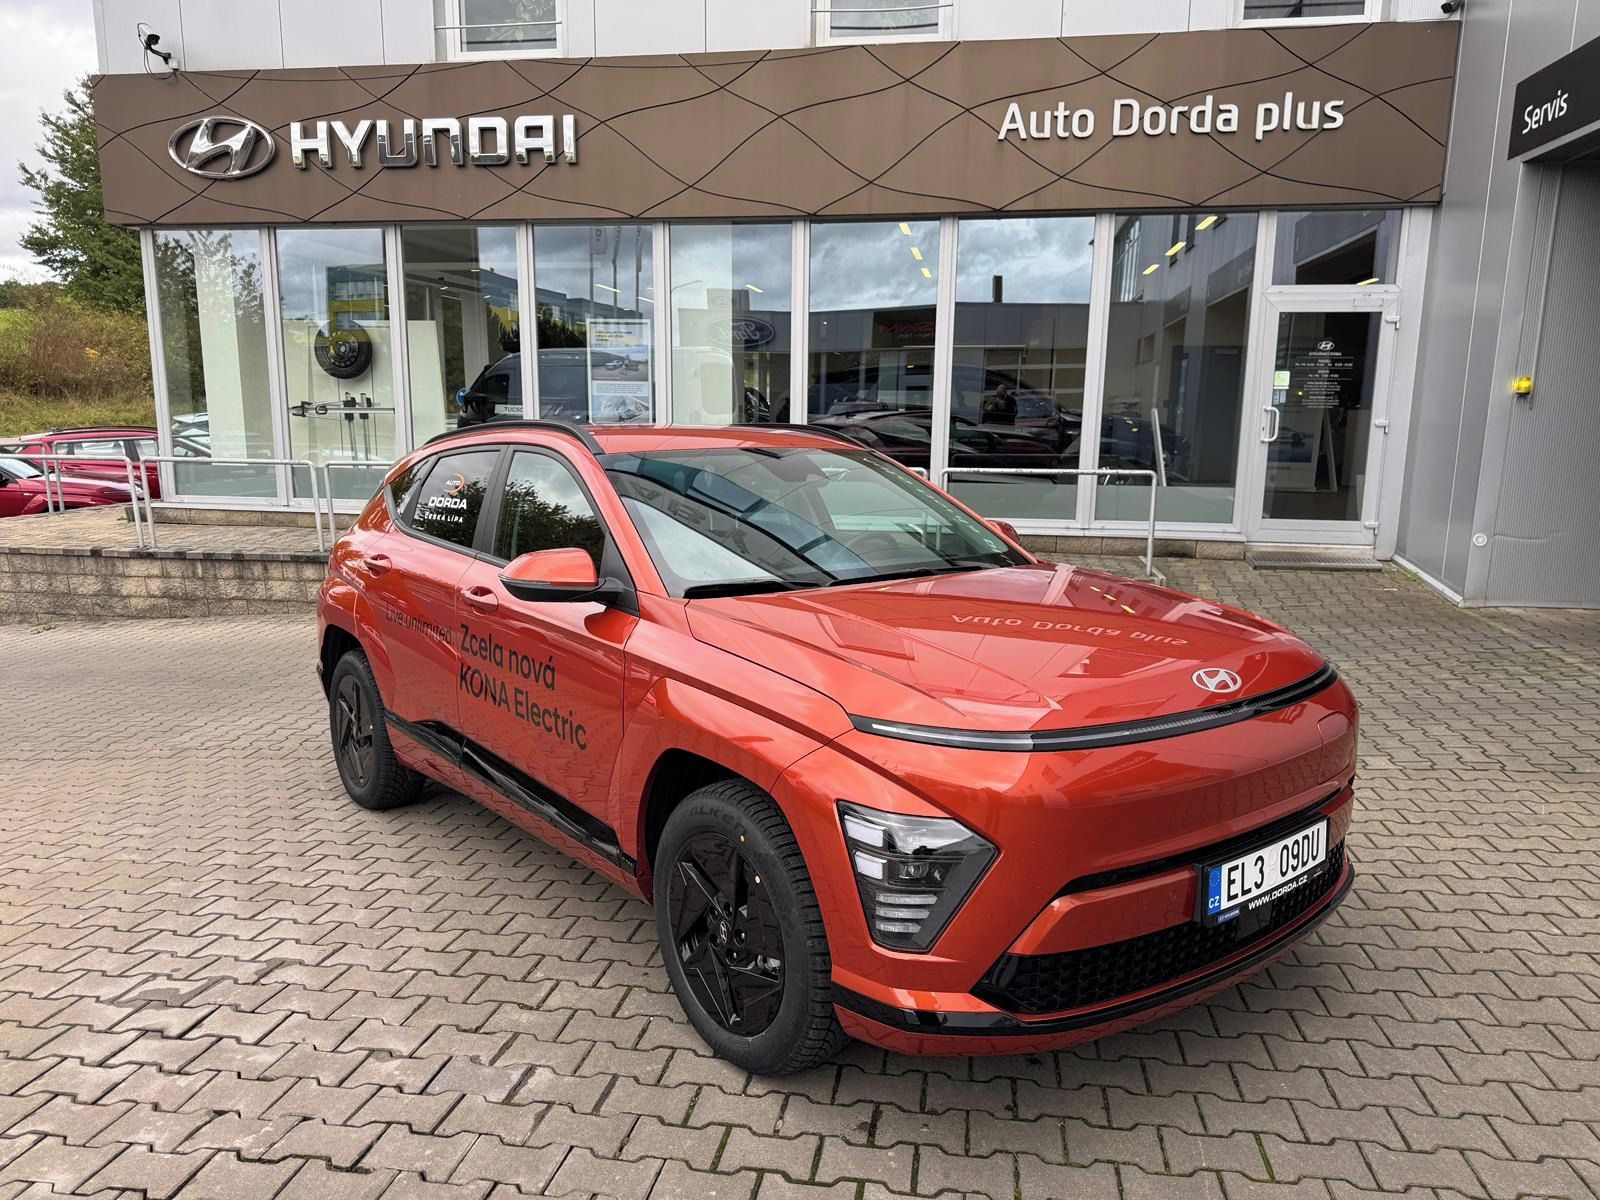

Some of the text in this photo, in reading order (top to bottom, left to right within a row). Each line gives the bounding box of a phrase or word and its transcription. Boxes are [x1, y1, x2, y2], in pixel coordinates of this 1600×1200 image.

[997, 91, 1345, 141] Auto Dorda plus
[1522, 89, 1569, 135] Servis
[290, 114, 577, 170] HYUNDAI
[424, 511, 463, 523] ČESKÁ LÍPA
[428, 496, 467, 510] DORDA
[385, 602, 403, 626] Live
[460, 622, 556, 691] Zcela nová
[459, 662, 587, 750] KONA Electric
[1227, 827, 1320, 902] EL3 09DU
[1208, 895, 1220, 909] CZ
